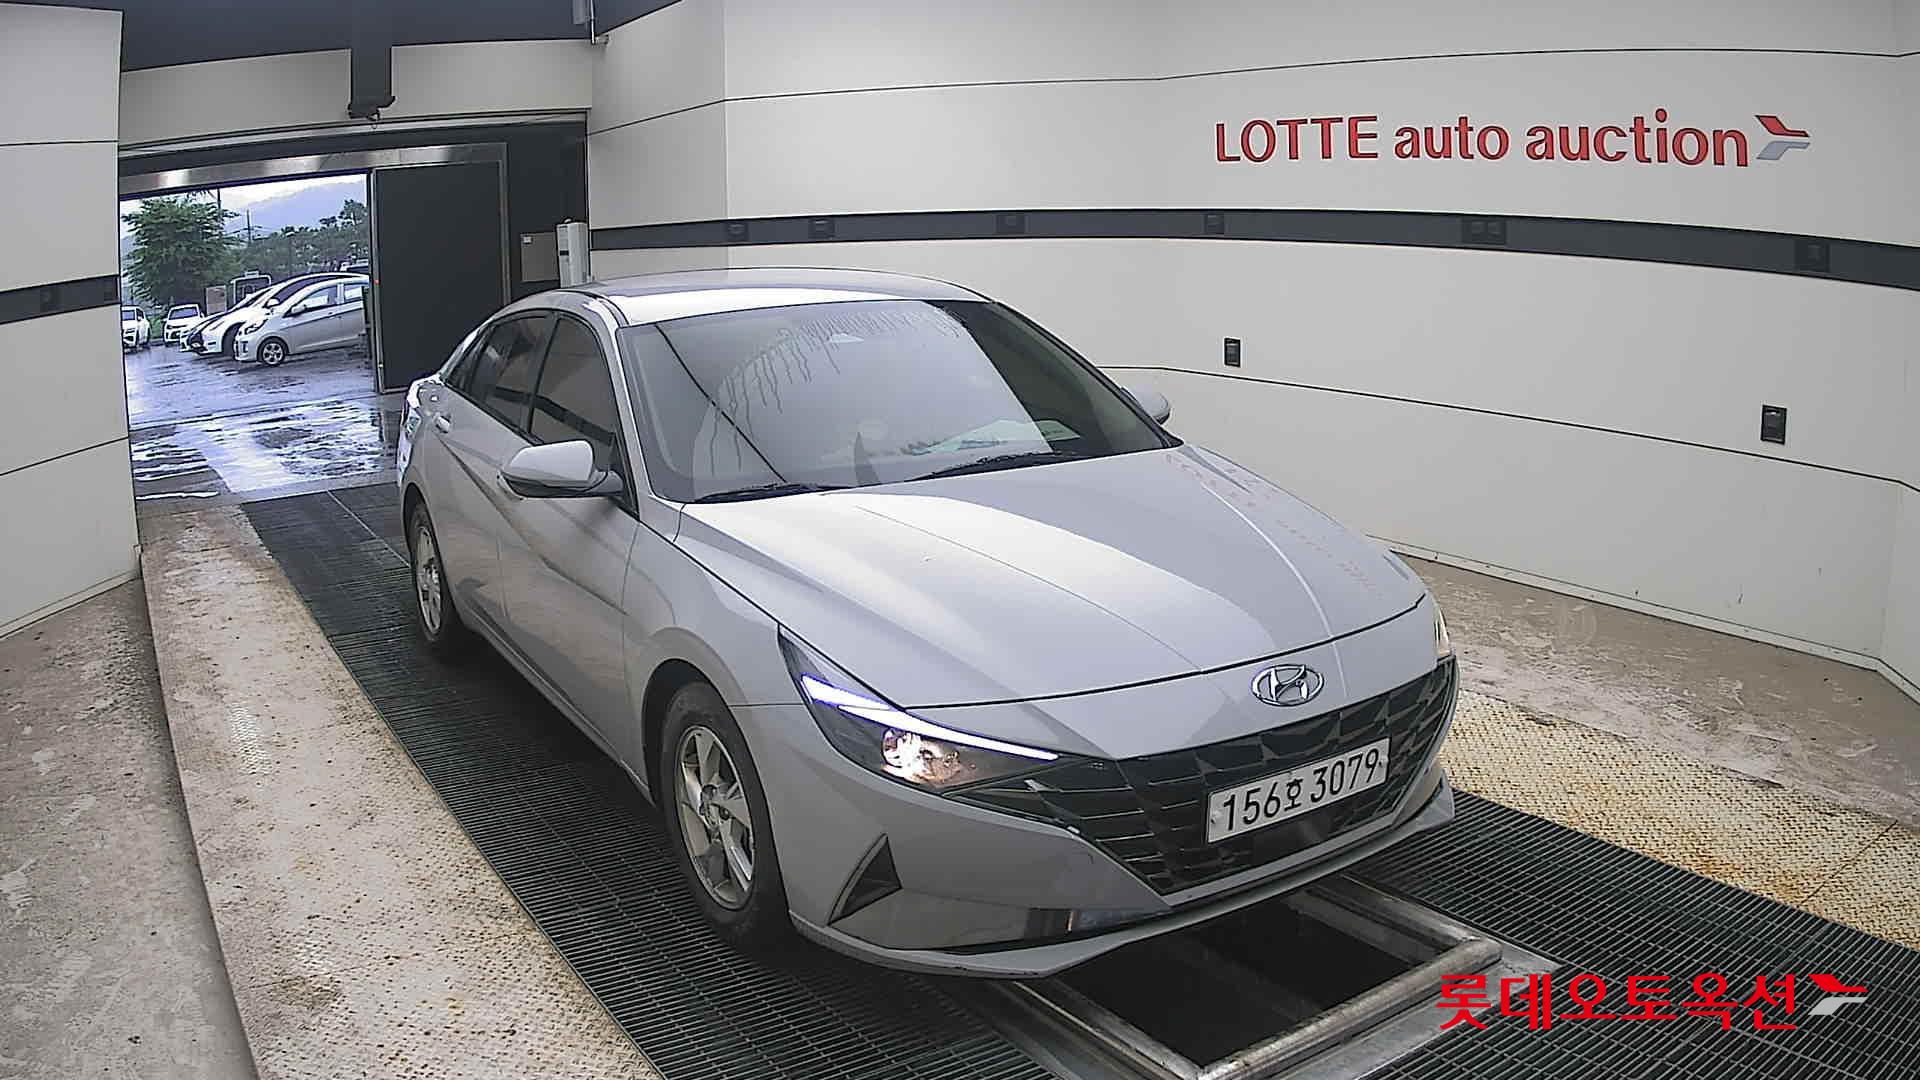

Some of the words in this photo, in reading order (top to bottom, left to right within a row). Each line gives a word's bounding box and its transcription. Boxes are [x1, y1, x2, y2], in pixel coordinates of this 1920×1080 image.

[1215, 115, 1379, 163] LOTTE
[1393, 115, 1510, 161] auto
[1524, 107, 1749, 168] auction
[1222, 778, 1303, 832] 156호
[1310, 748, 1380, 803] 3079
